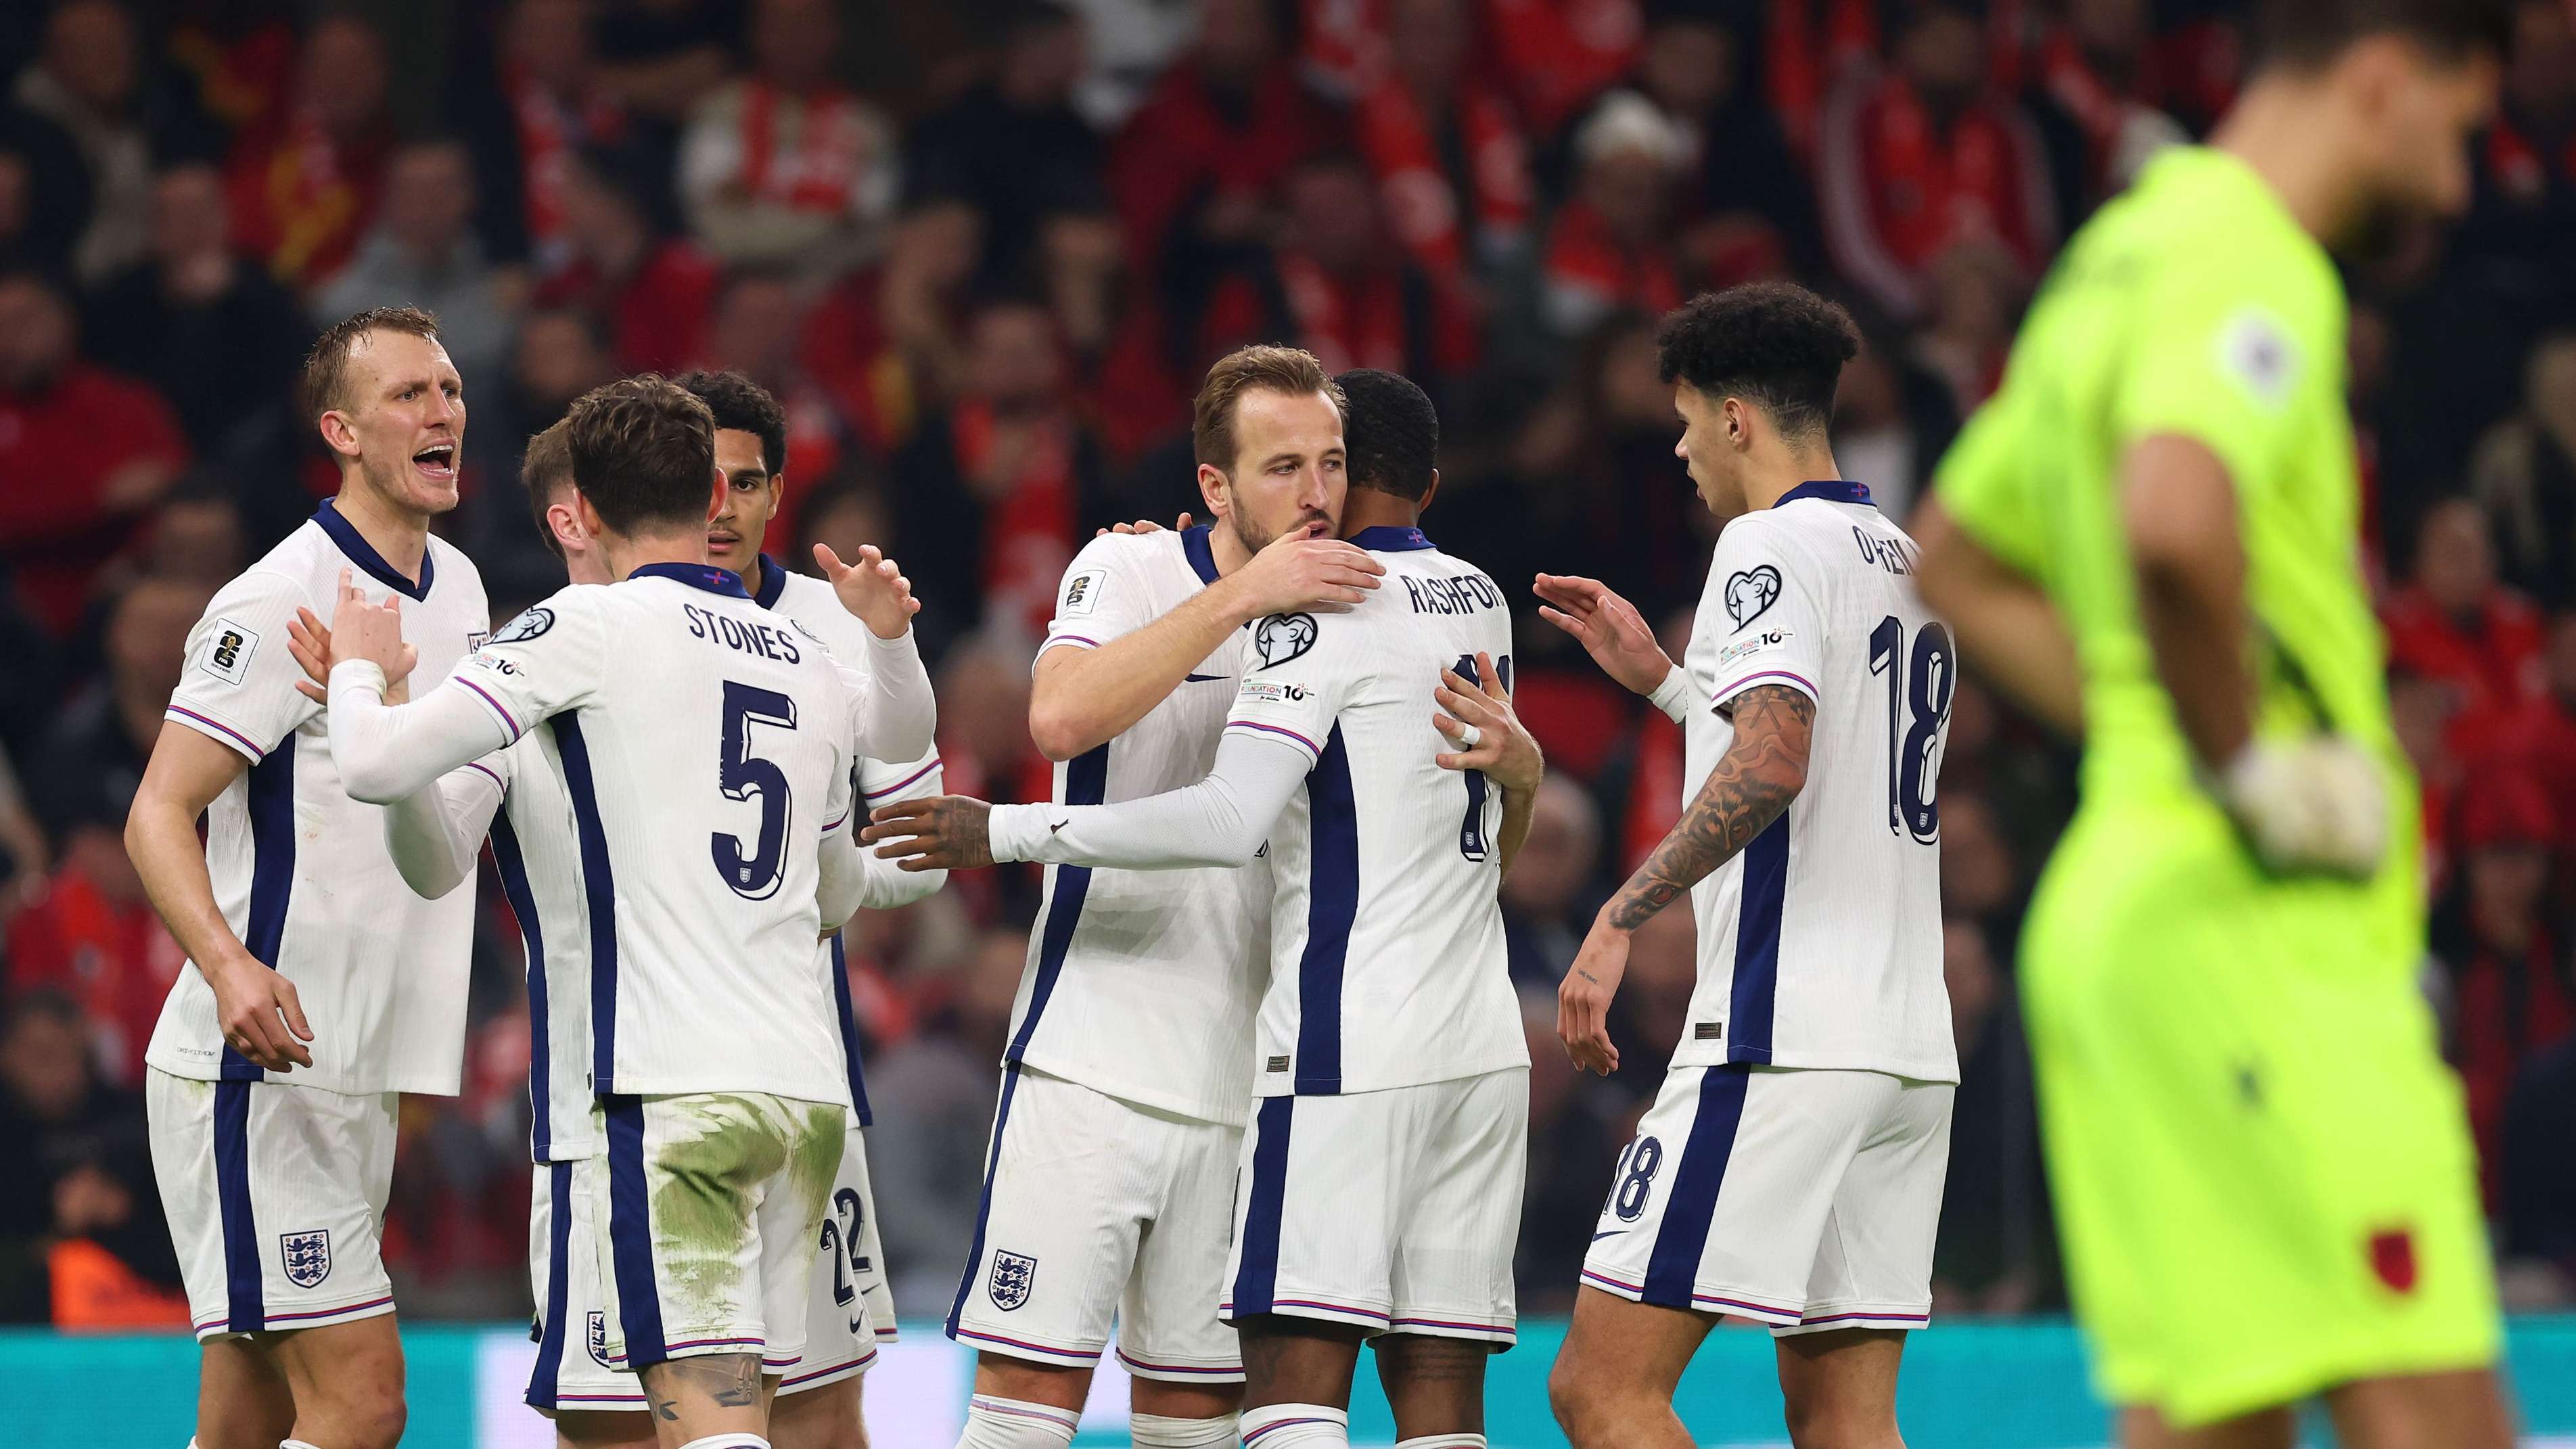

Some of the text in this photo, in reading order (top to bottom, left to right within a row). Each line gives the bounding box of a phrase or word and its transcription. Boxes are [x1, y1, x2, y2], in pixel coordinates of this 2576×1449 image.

[684, 603, 800, 664] STONES
[711, 679, 797, 901] 5
[1869, 615, 1957, 846] 18
[1603, 1134, 1663, 1223] 18
